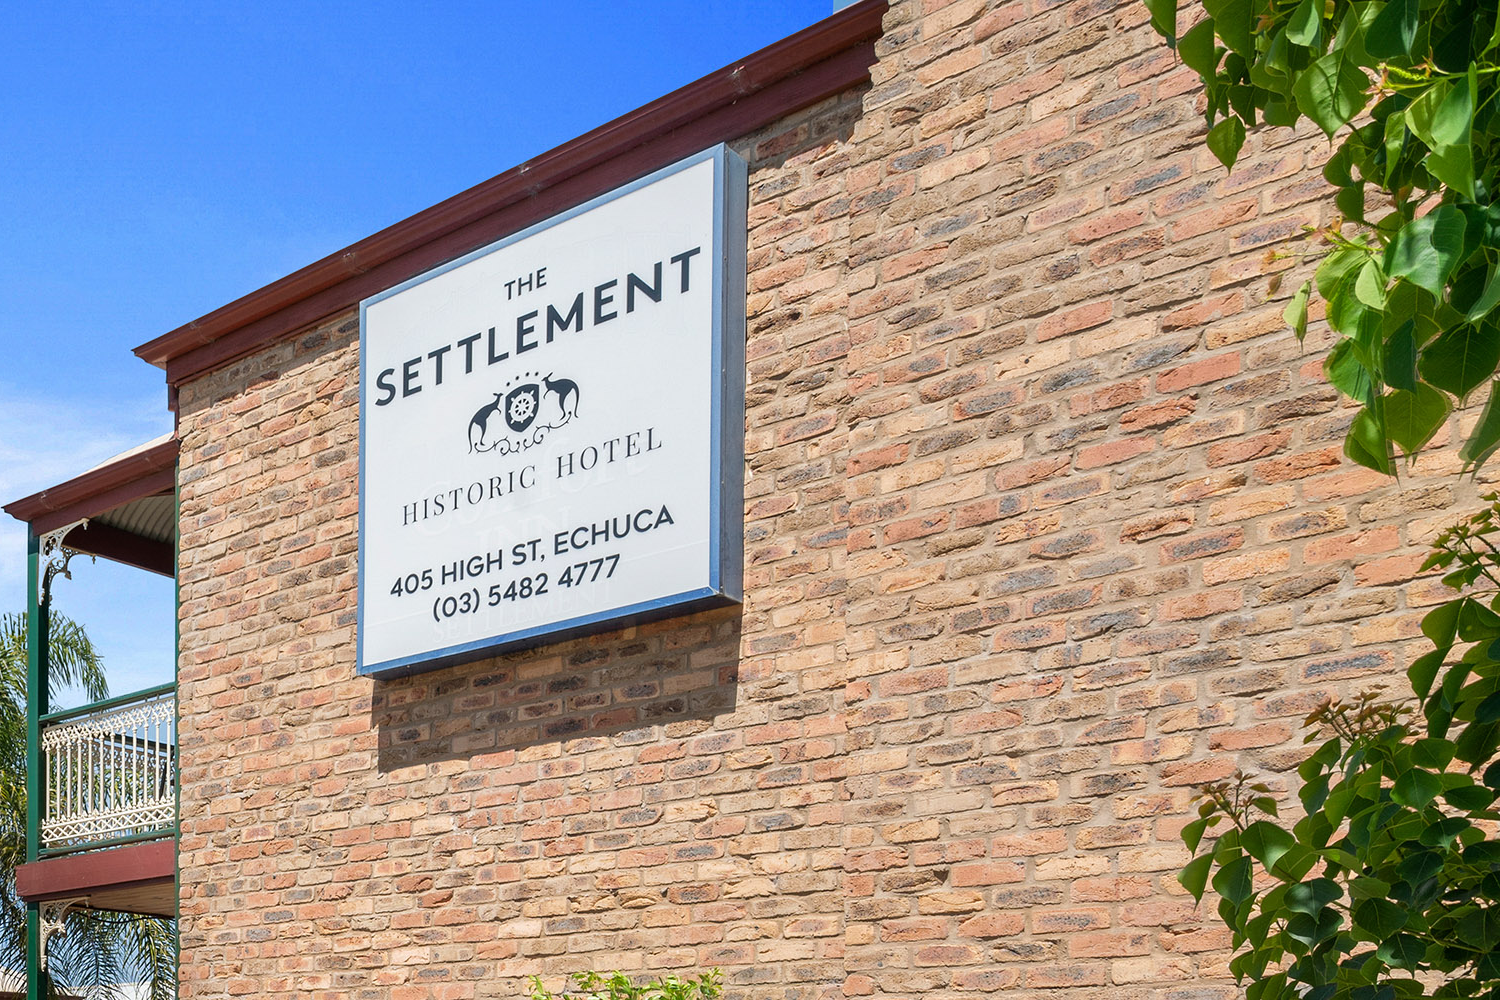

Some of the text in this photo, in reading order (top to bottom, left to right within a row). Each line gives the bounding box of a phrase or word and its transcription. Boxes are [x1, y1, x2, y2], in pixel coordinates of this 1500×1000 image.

[374, 246, 701, 407] SETTLEMENT
[504, 267, 547, 300] THE
[402, 427, 663, 526] HISTORIC HOTEL
[390, 504, 675, 598] 405 HIGH ST, ECHUCA
[433, 554, 621, 623] (03) 5482 4777
